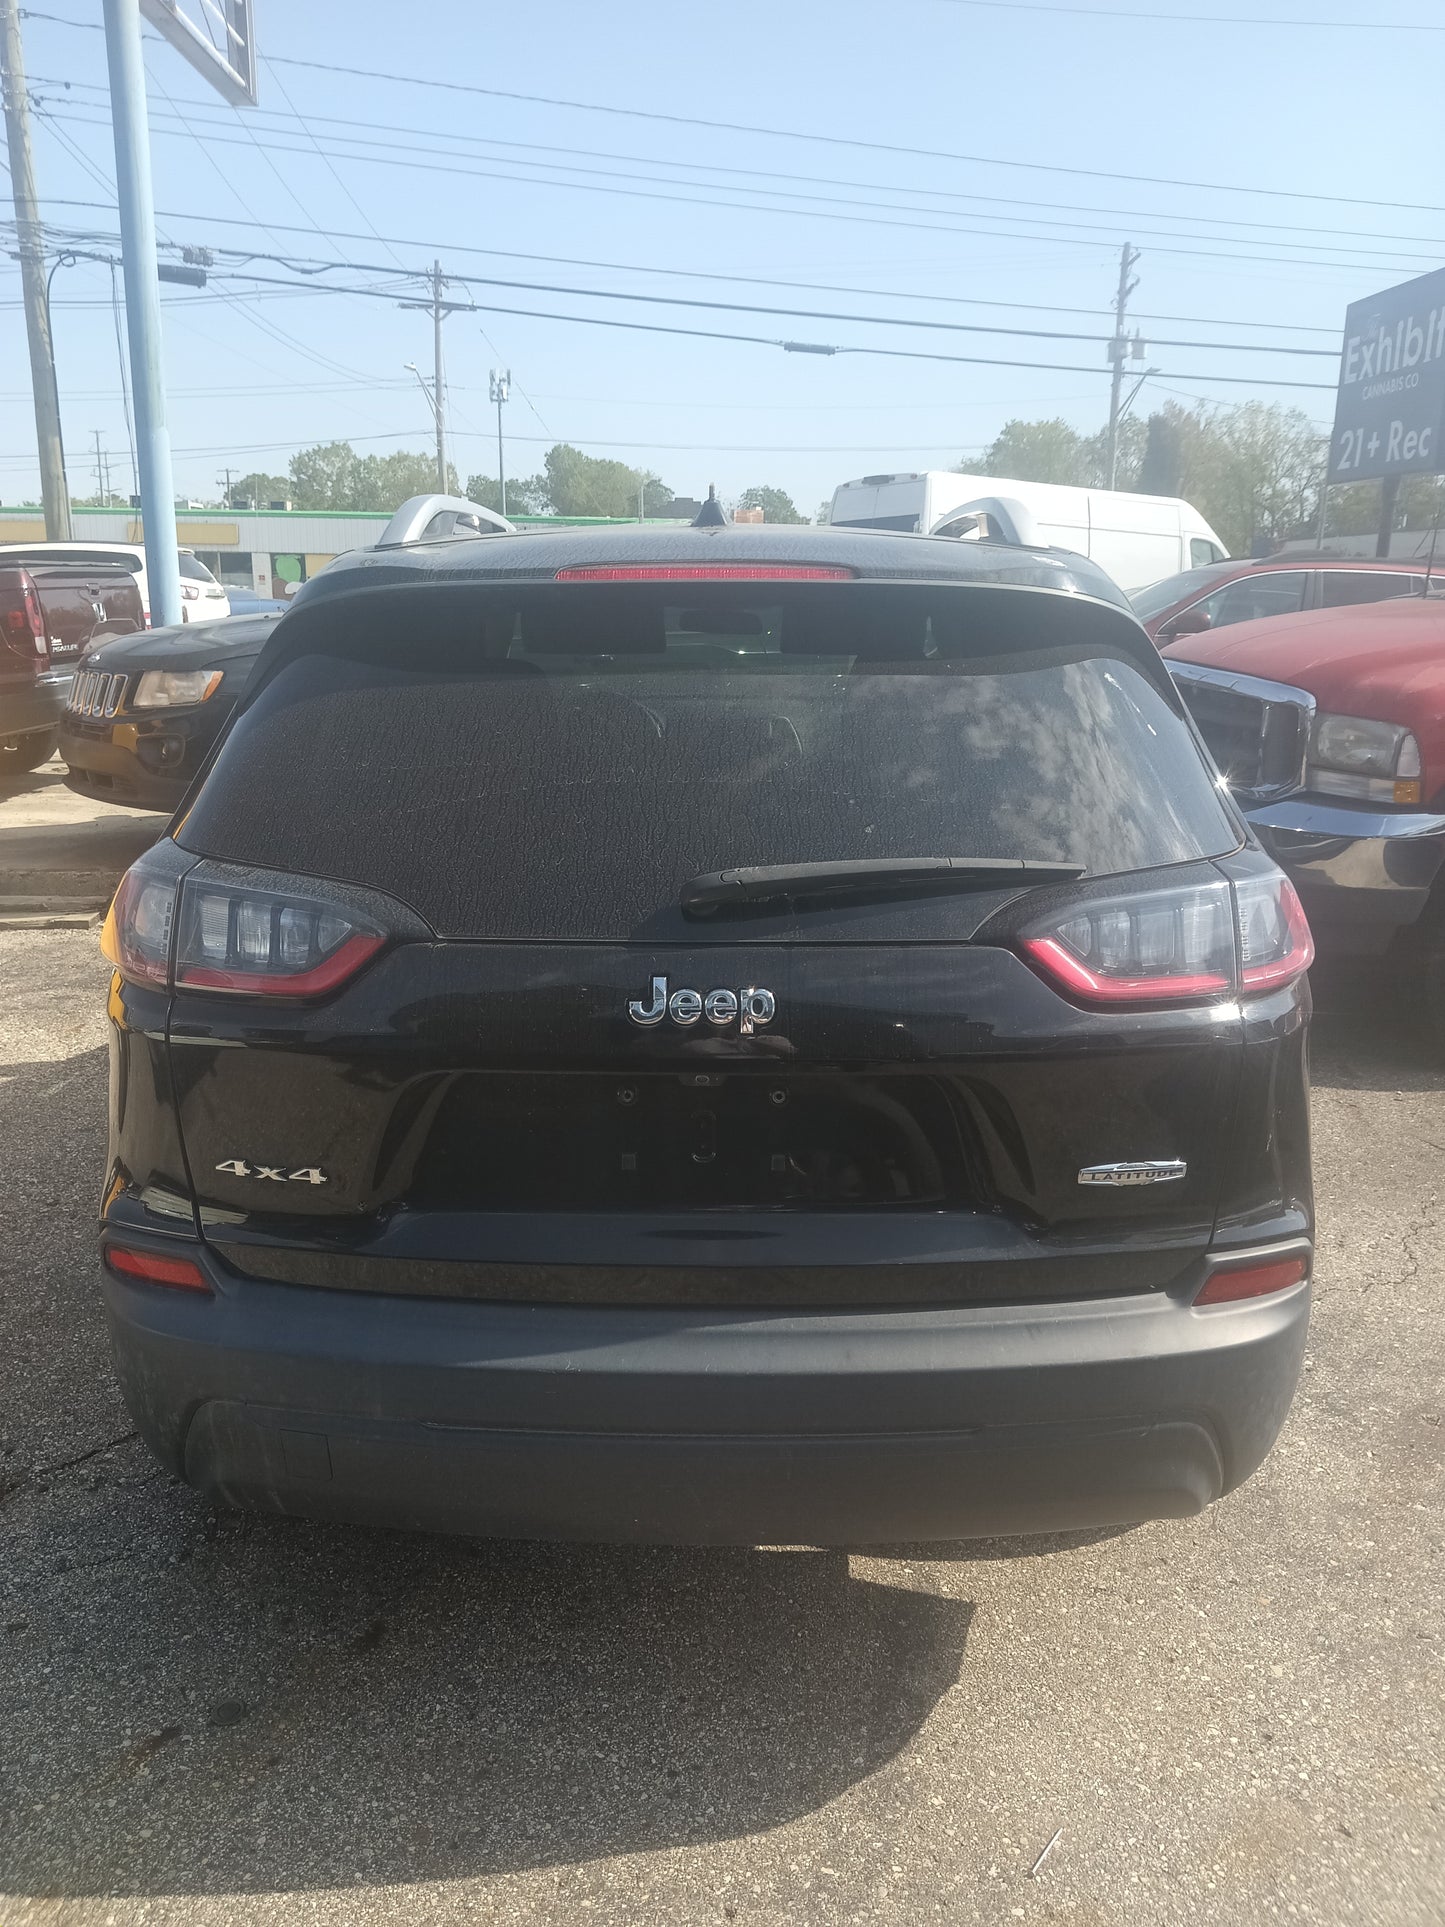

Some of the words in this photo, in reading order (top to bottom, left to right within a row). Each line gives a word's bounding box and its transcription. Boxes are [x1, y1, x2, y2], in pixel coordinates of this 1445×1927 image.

[1362, 375, 1404, 400] CANNABIS
[1385, 419, 1432, 463] Rec
[628, 976, 775, 1034] Jeep
[215, 1160, 328, 1185] 4x4
[1091, 1169, 1178, 1181] LATITUDE
